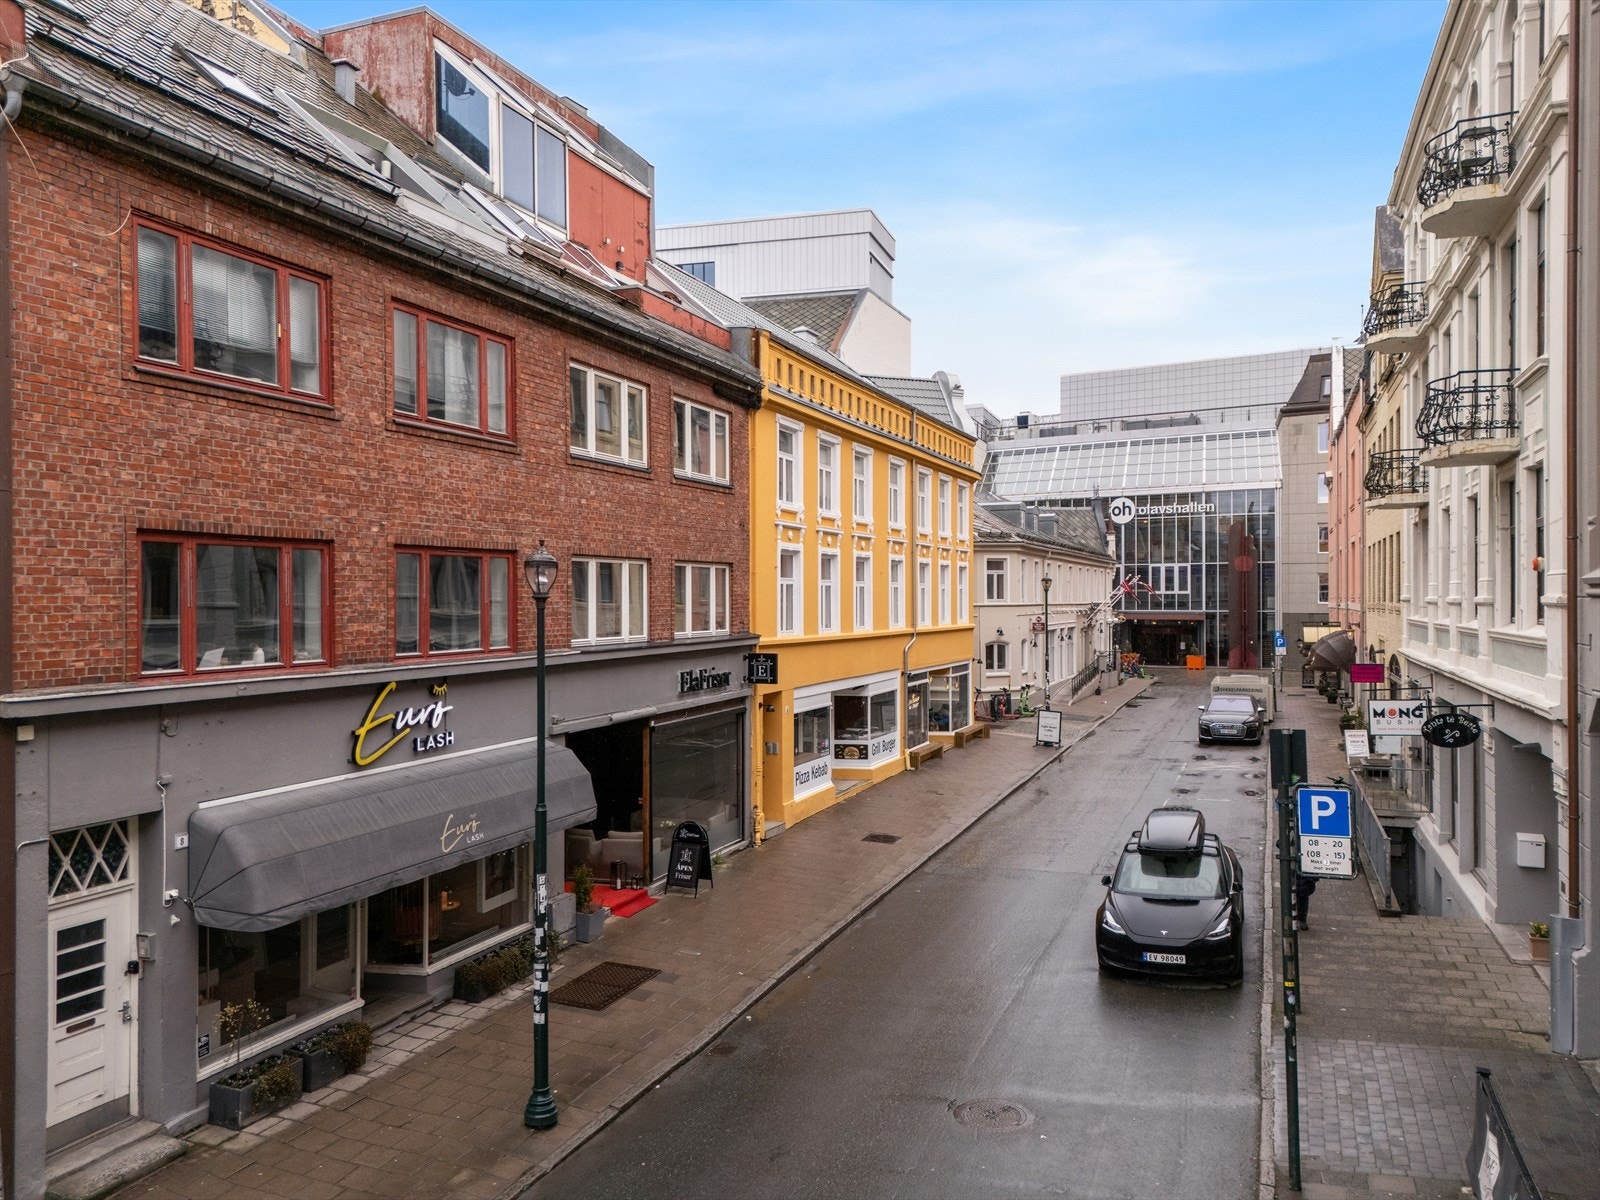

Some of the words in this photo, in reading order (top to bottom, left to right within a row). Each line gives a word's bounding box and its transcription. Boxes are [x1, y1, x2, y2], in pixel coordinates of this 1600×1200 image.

[1111, 501, 1132, 517] oh
[1138, 501, 1215, 514] olavshallen
[1277, 638, 1284, 647] P
[1373, 705, 1424, 719] MONG
[417, 731, 454, 751] LASH
[872, 742, 881, 756] Grill
[882, 738, 896, 753] Burger
[795, 771, 810, 787] Pizza
[811, 761, 828, 780] Kebab
[1311, 795, 1336, 830] P
[466, 832, 484, 844] LASH
[1308, 839, 1319, 847] 08
[1332, 840, 1343, 848] 20
[1306, 850, 1321, 858] (08
[1334, 852, 1346, 860] 15)
[1148, 953, 1158, 961] EV
[1160, 955, 1184, 963] 98049
